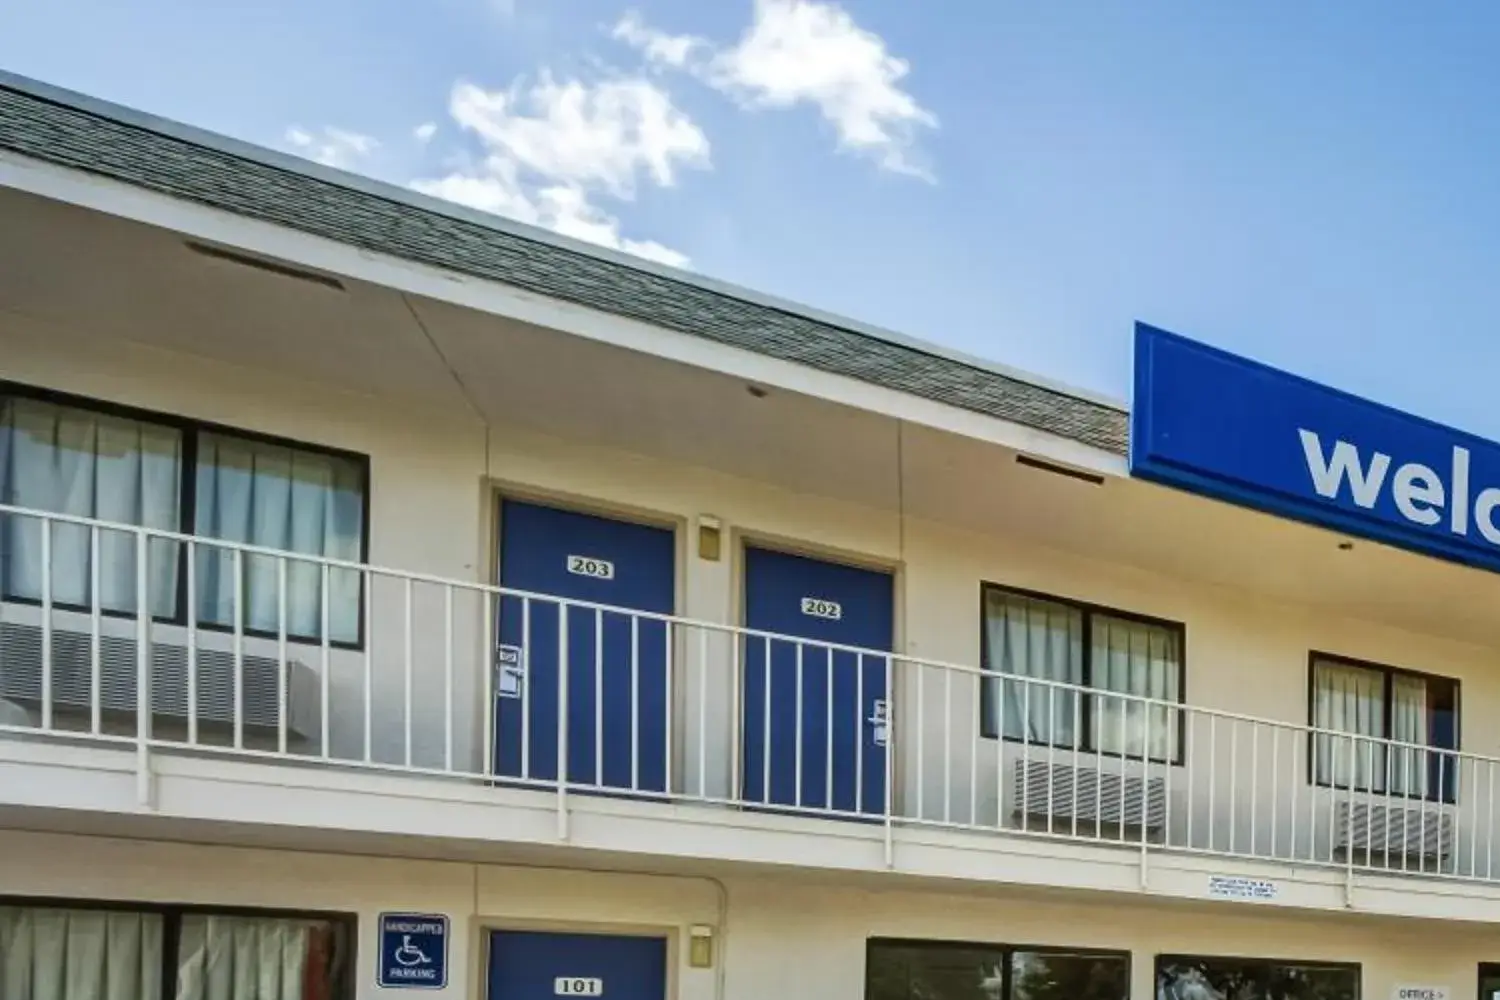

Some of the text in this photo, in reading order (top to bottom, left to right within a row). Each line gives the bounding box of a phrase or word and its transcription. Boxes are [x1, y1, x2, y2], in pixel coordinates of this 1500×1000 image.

[572, 558, 609, 577] 203
[806, 601, 837, 617] 202
[385, 921, 443, 936] HANDICAPPED
[389, 967, 437, 979] PARKING
[563, 979, 595, 993] 101
[1399, 989, 1435, 1000] OFFICE
